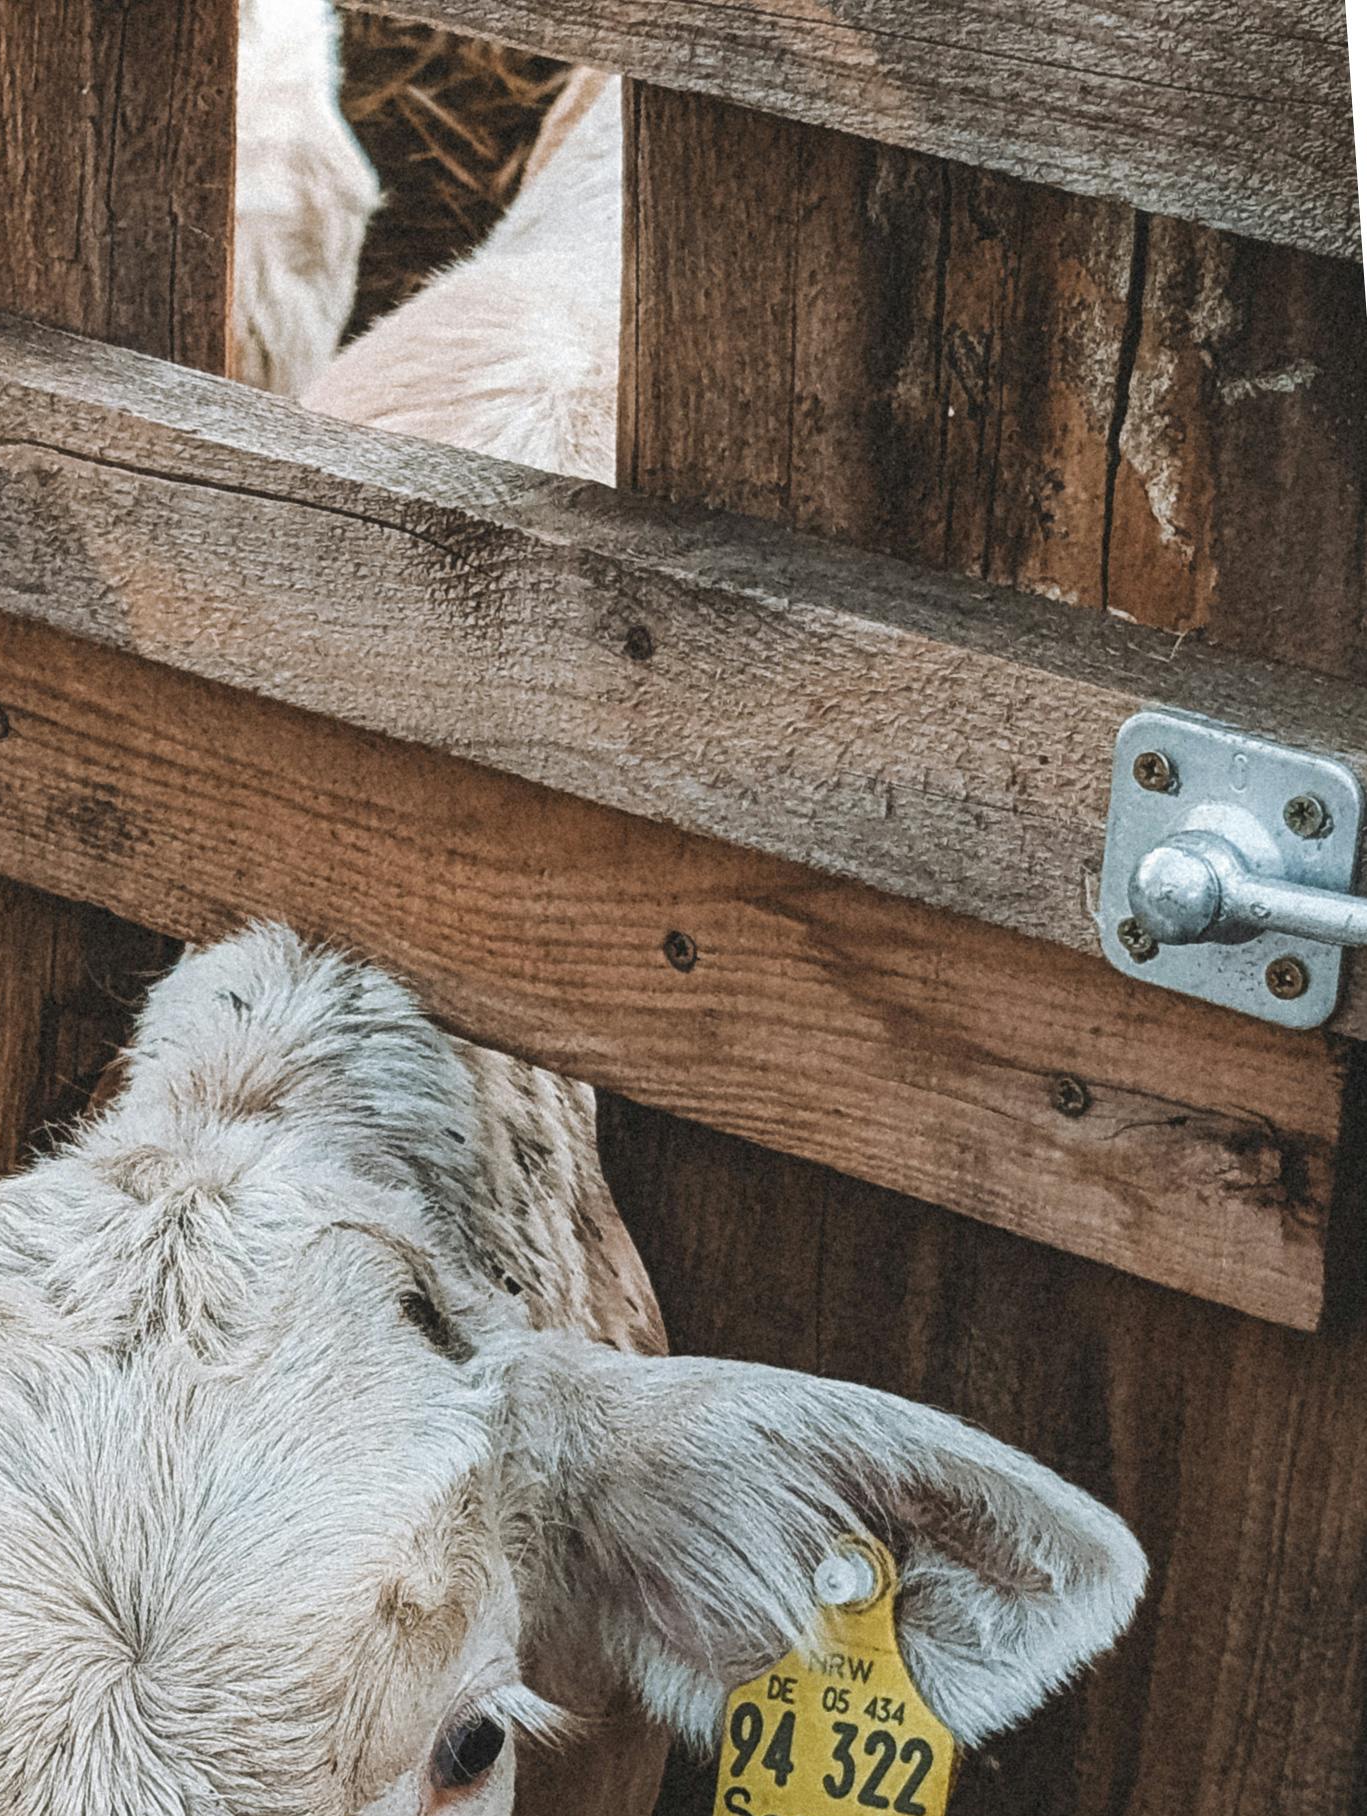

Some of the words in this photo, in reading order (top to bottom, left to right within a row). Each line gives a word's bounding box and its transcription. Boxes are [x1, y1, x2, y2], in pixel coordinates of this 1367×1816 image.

[807, 1648, 874, 1684] NRW
[767, 1674, 798, 1703] DE
[822, 1685, 850, 1714] 05
[863, 1697, 906, 1726] 434
[729, 1701, 797, 1788] 94
